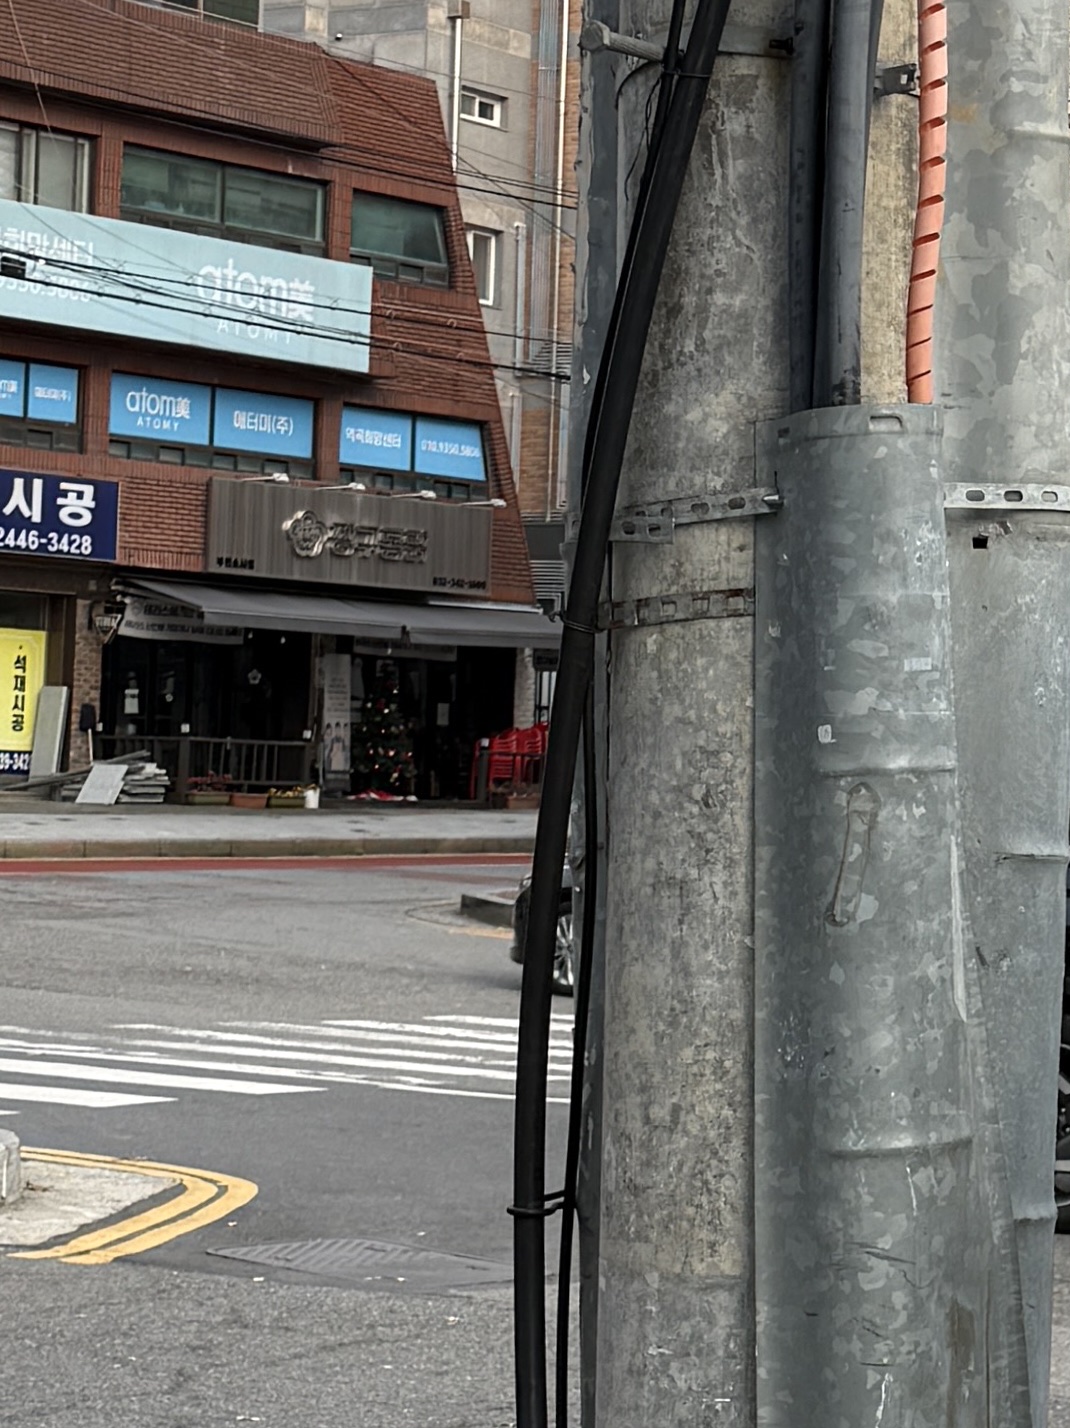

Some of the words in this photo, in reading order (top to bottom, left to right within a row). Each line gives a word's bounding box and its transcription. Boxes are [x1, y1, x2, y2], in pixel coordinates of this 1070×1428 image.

[137, 416, 179, 431] ATOMY
[233, 410, 294, 437] 애터미(주)
[12, 654, 27, 732] 석재시공
